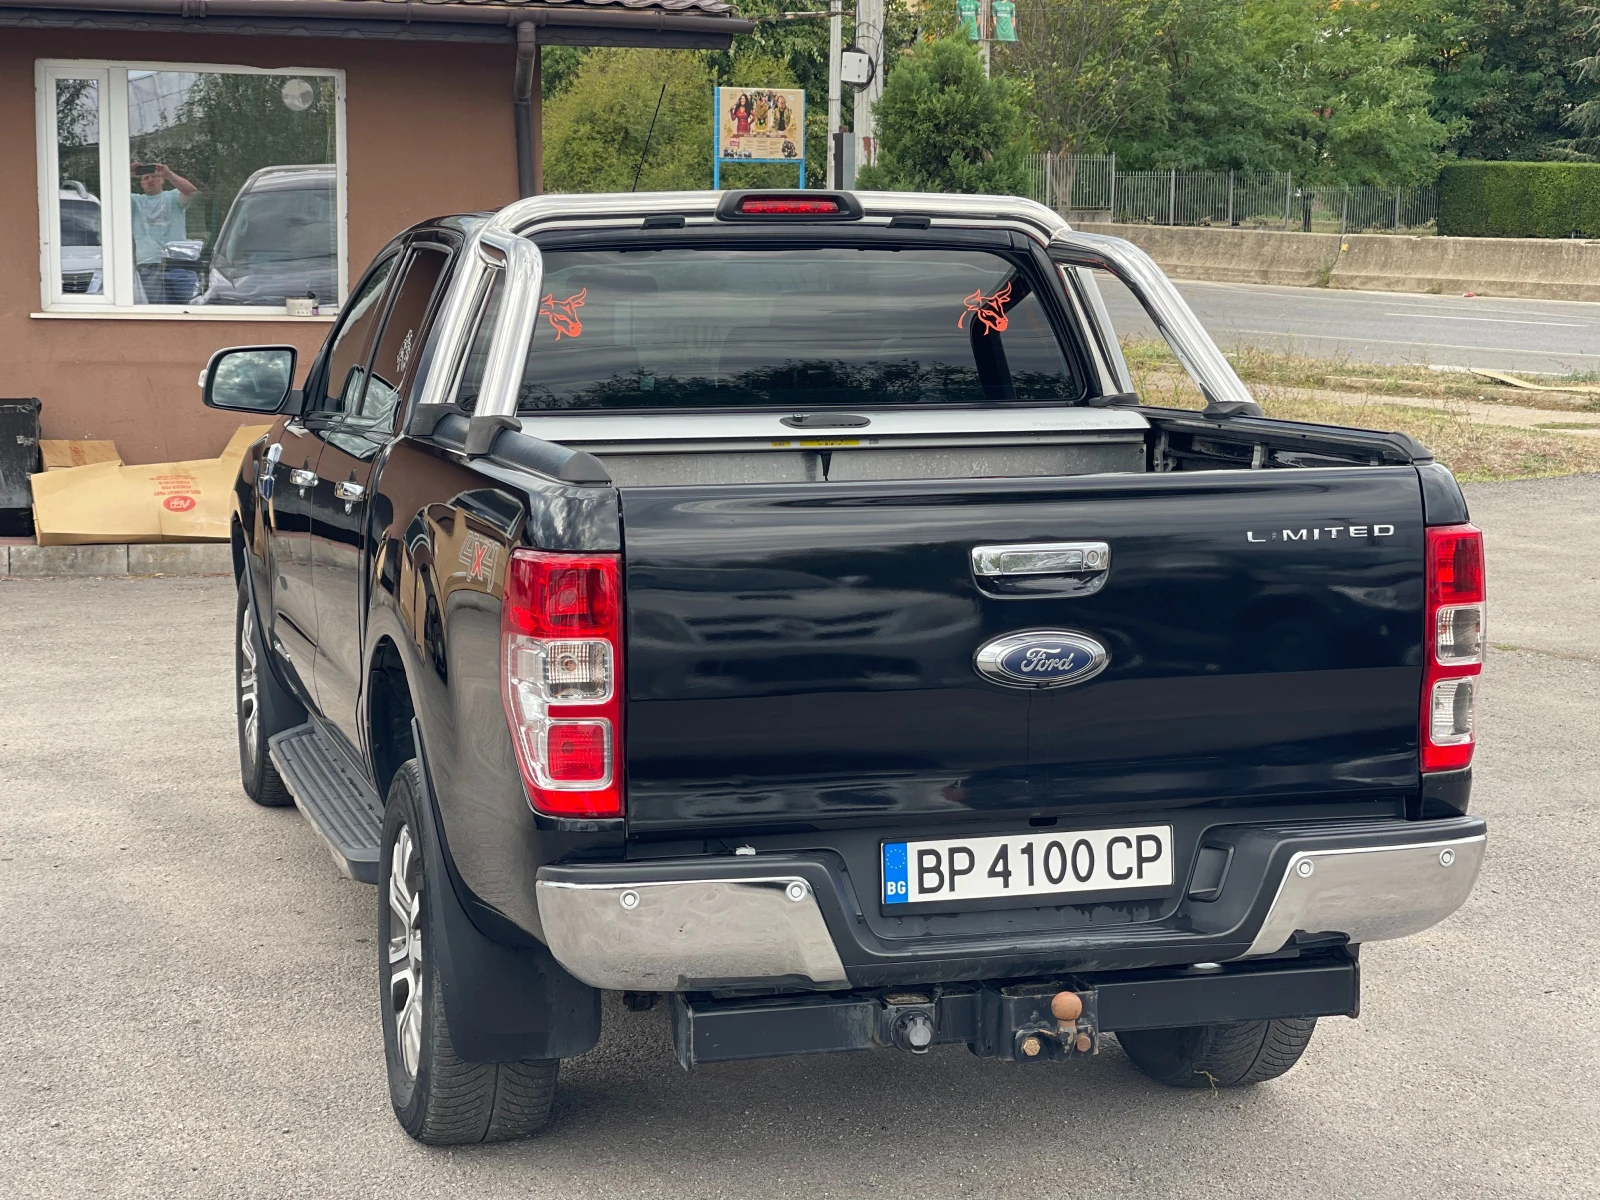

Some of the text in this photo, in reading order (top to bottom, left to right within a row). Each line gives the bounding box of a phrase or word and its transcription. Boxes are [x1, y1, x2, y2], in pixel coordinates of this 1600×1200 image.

[1247, 525, 1394, 542] LIMITED
[1021, 648, 1074, 672] Ford
[917, 834, 1162, 894] BP 4100 CP
[887, 880, 907, 896] BG
